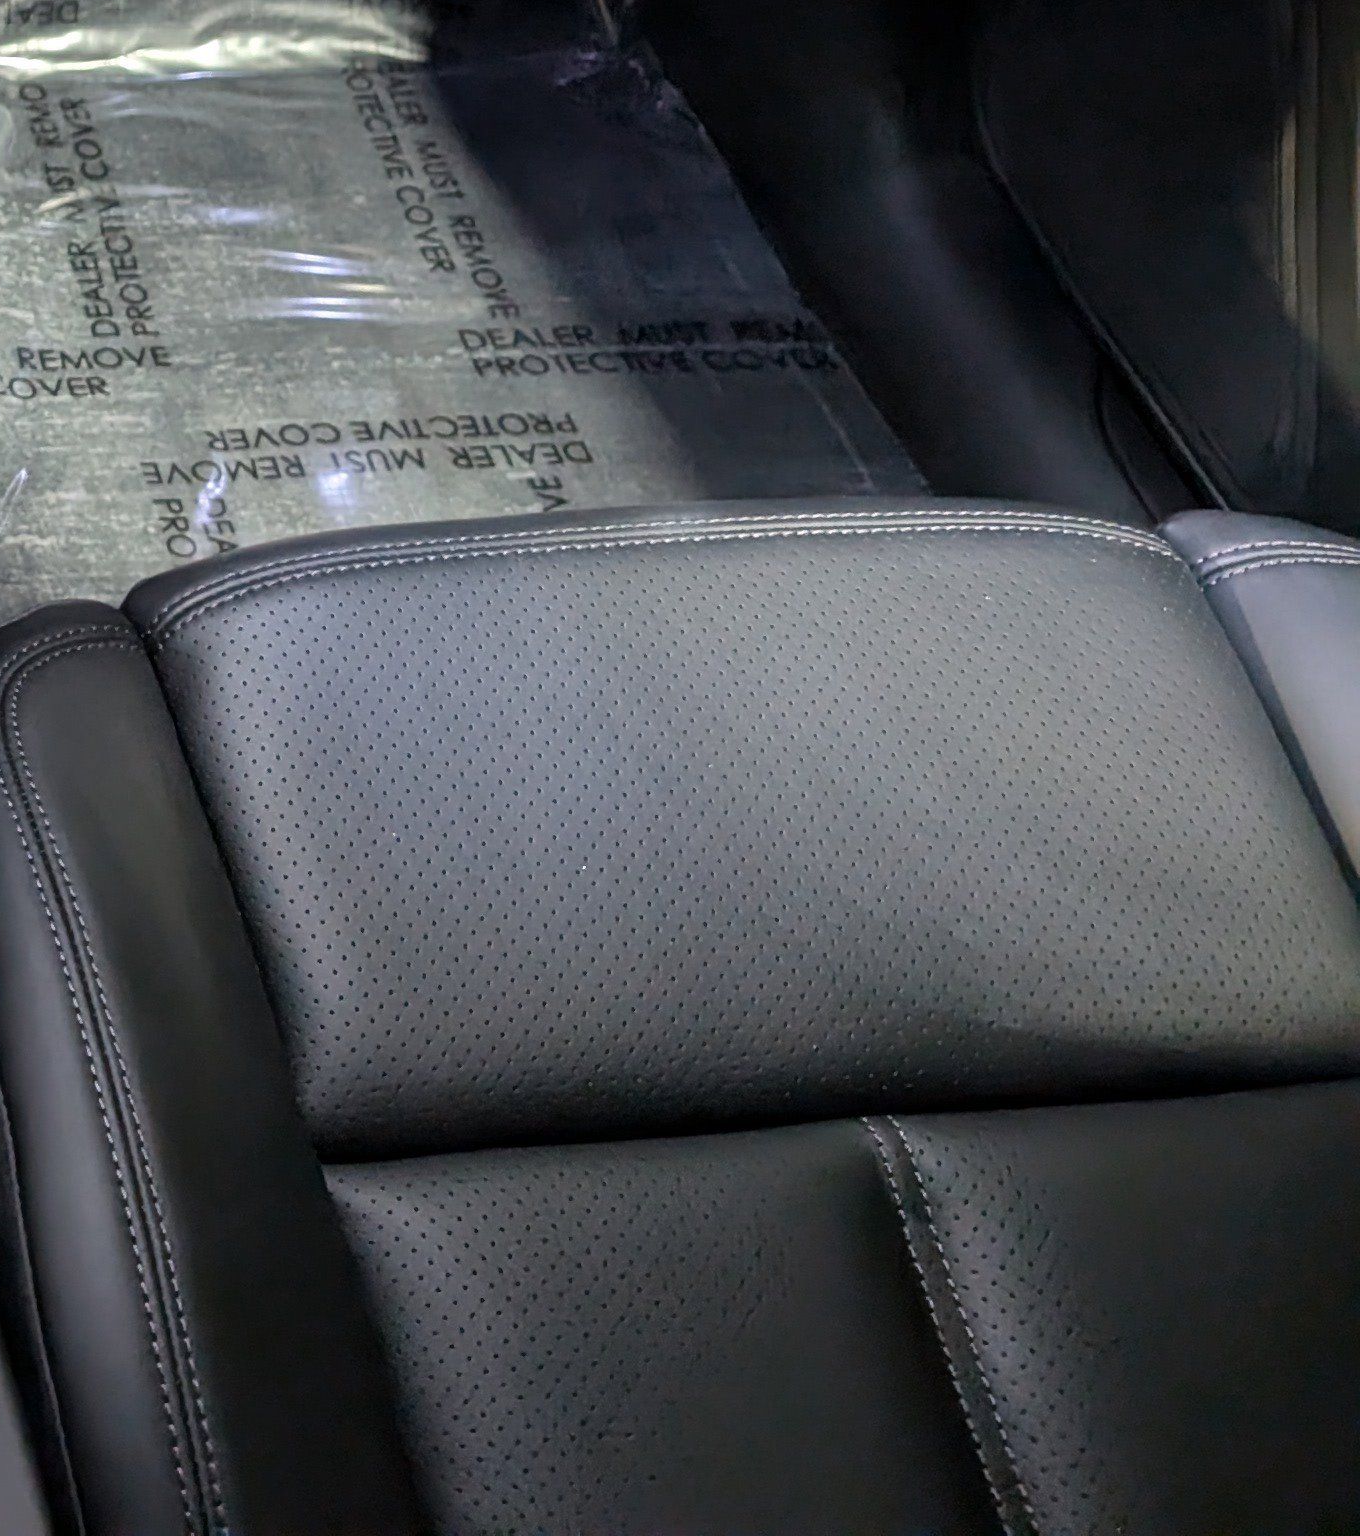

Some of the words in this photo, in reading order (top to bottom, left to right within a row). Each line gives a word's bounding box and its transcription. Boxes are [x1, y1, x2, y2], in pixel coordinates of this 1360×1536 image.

[20, 83, 62, 148] REMO
[60, 97, 109, 182] COVER
[395, 187, 456, 275] COVER
[414, 139, 464, 203] MUST
[447, 214, 520, 321] REMOVE
[93, 187, 159, 337] PROTECTIVE
[68, 240, 120, 338] DEALER
[458, 323, 596, 353] DEALER
[17, 345, 173, 372] REMOVE
[472, 348, 693, 378] PROTECTIVE
[207, 423, 342, 452] COVER
[353, 411, 579, 443] PROTECTIVE
[330, 446, 426, 473] MUST
[451, 440, 594, 468] DEALER
[140, 454, 306, 487] REMOVE
